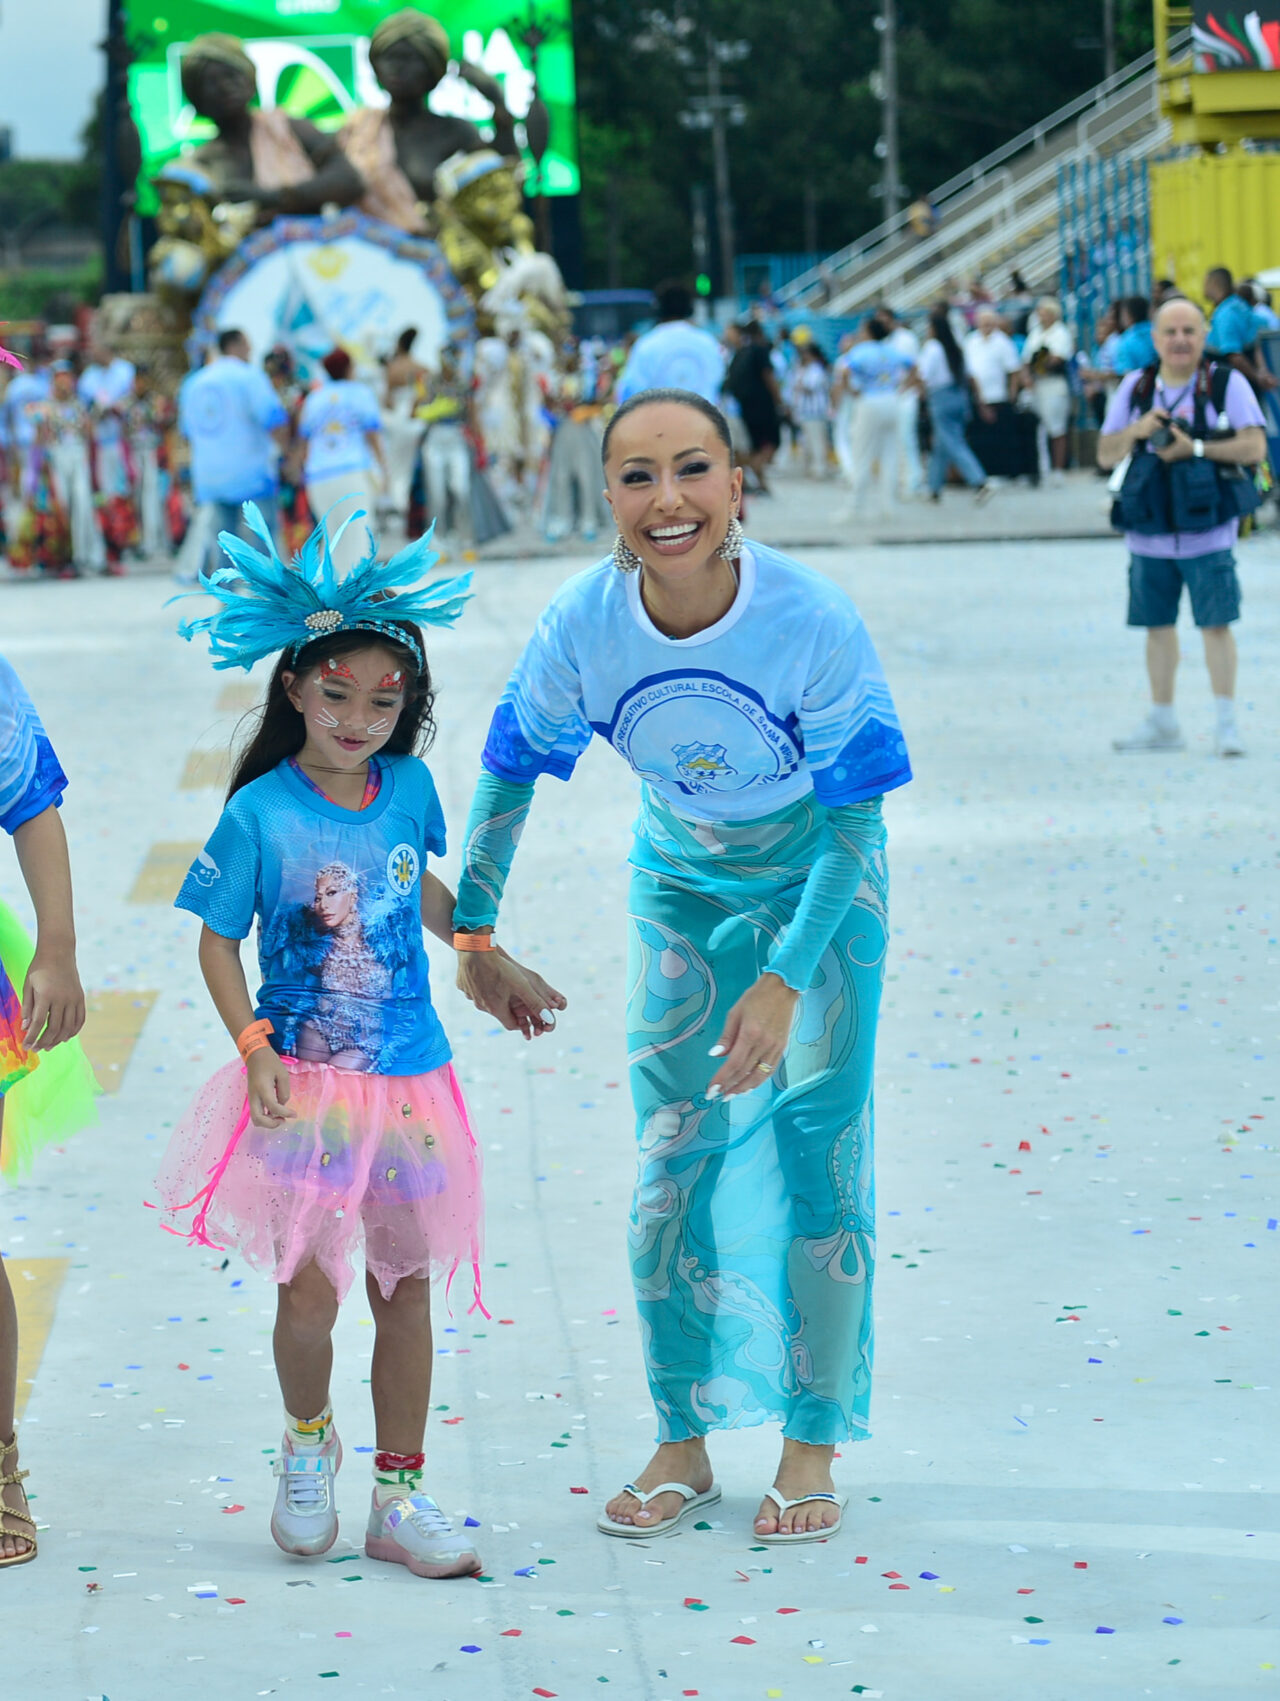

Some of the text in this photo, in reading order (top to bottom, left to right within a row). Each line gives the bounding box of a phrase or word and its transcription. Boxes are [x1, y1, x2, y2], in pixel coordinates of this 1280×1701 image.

[648, 683, 698, 702] CULTURAL
[701, 683, 740, 705] ESCOLA
[742, 703, 757, 716] DE
